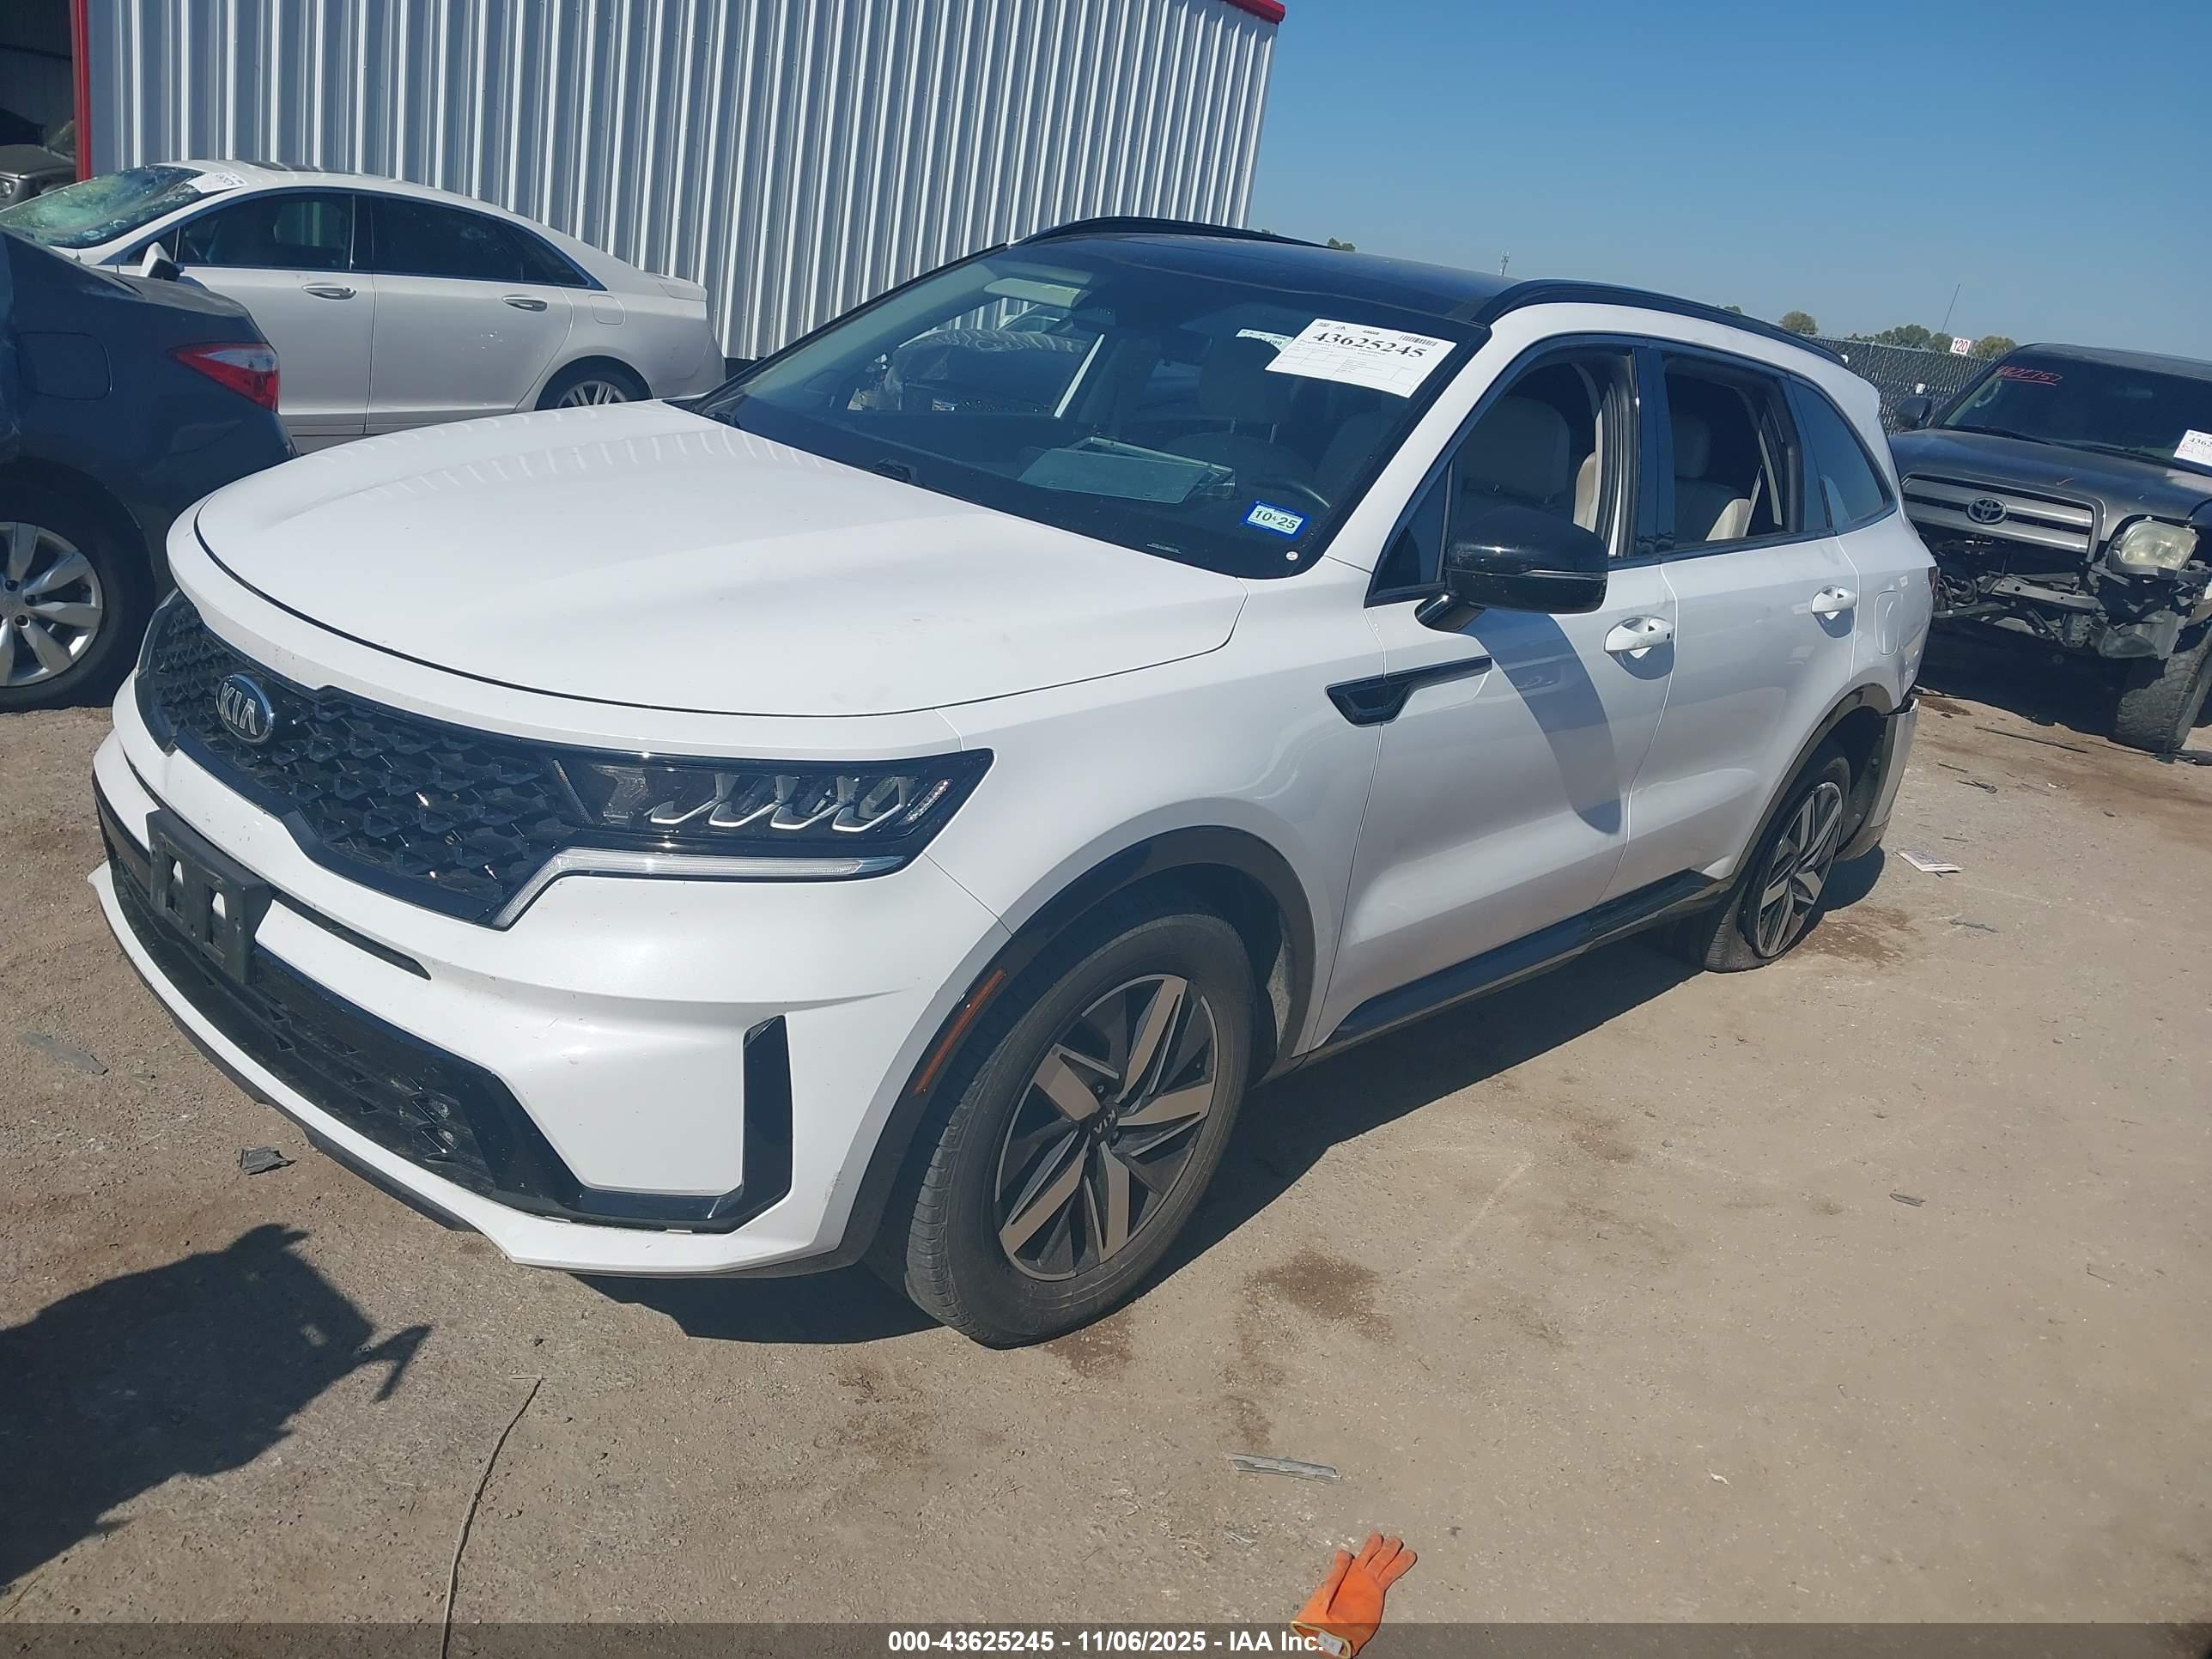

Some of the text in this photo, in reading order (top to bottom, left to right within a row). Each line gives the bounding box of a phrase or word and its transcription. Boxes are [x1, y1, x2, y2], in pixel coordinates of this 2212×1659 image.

[1312, 332, 1427, 357] 43625245
[1954, 339, 1969, 353] 120
[220, 682, 257, 736] KIA
[1093, 1109, 1115, 1133] KIA
